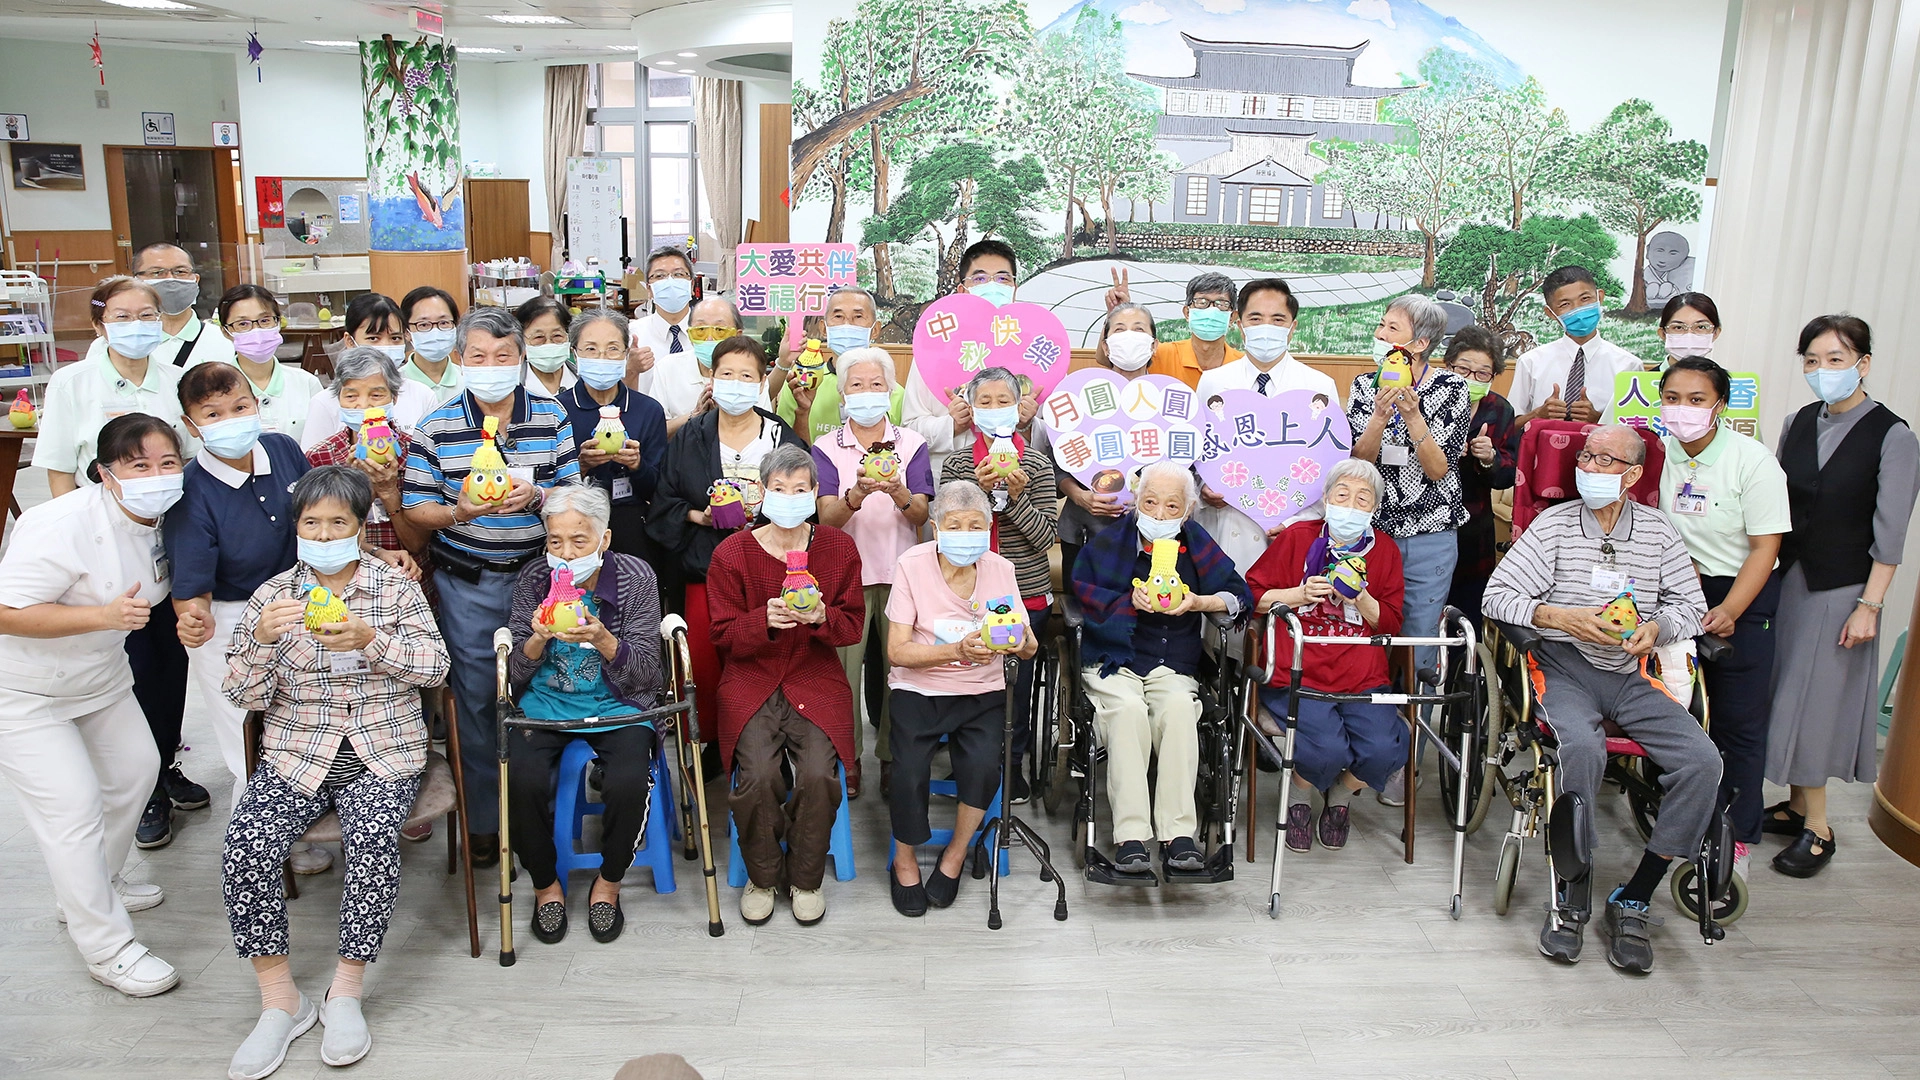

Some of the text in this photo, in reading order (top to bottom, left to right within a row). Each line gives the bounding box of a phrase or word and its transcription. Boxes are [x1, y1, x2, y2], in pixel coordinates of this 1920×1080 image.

[740, 249, 855, 278] 大愛共伴
[740, 284, 850, 312] 造福行
[1048, 382, 1192, 428] 月圓人圓
[1059, 428, 1196, 468] 事圓理圓
[1201, 411, 1350, 462] 感恩上人
